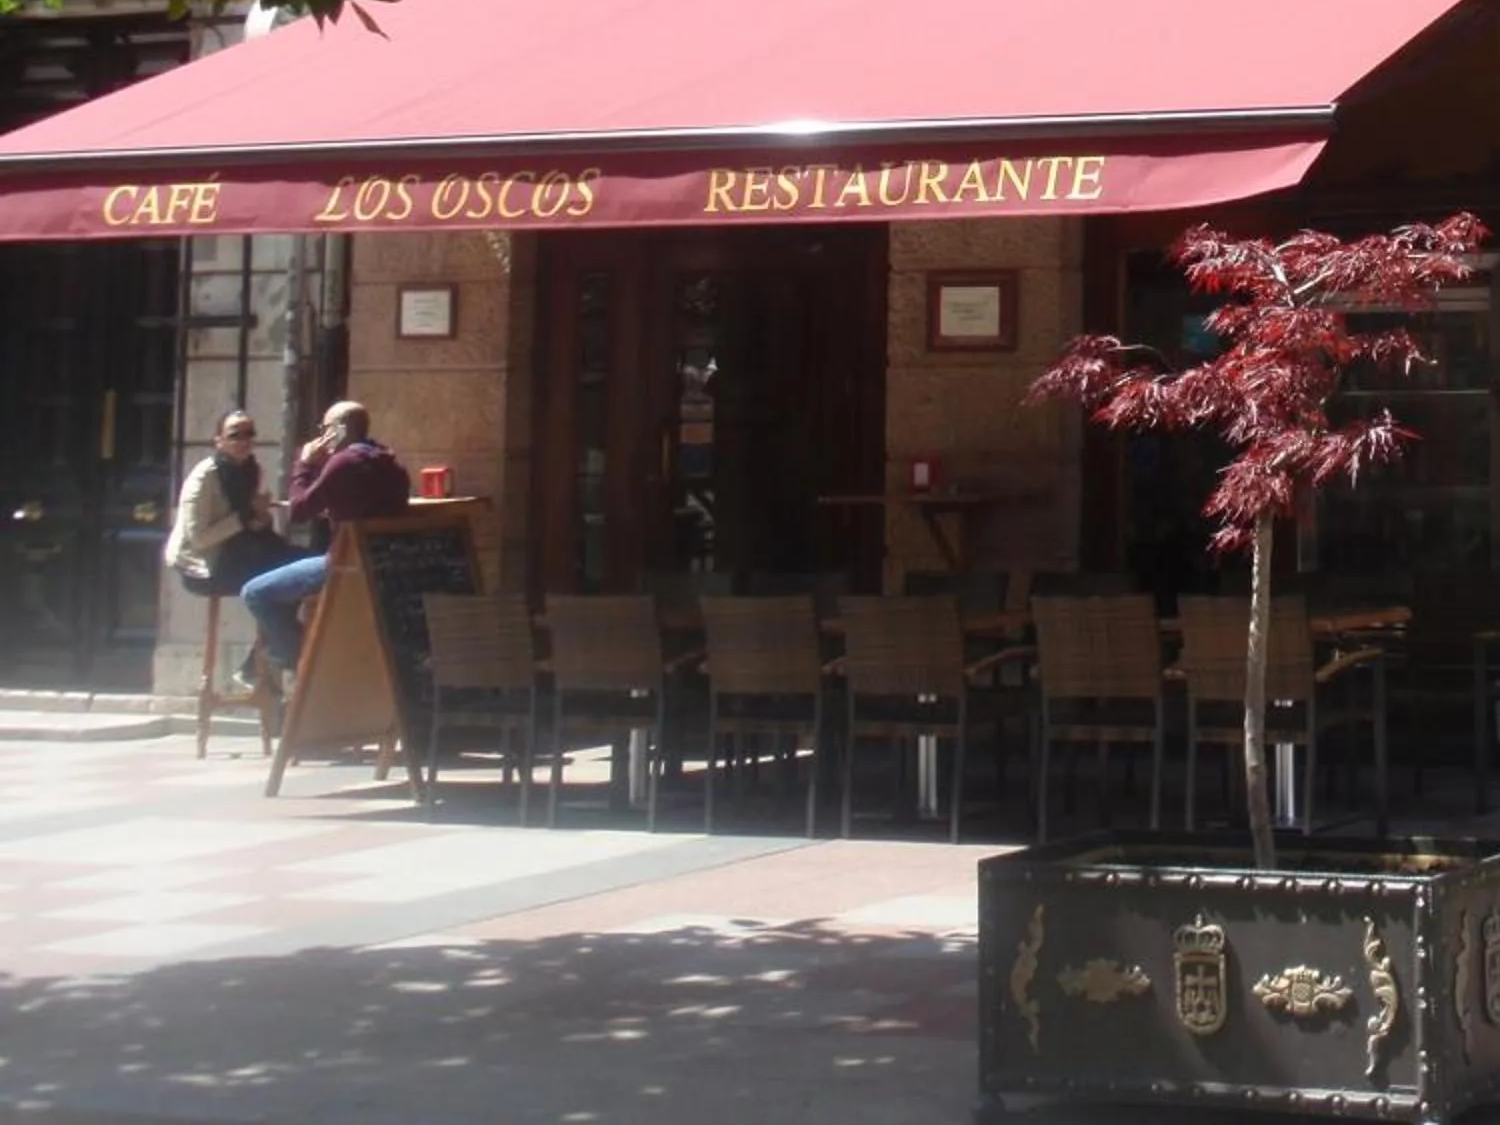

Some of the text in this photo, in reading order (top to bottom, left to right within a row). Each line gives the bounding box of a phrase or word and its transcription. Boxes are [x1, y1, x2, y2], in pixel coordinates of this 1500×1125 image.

[102, 156, 1107, 226] CAFÉ LOS OSCOS RESTAURANTE
